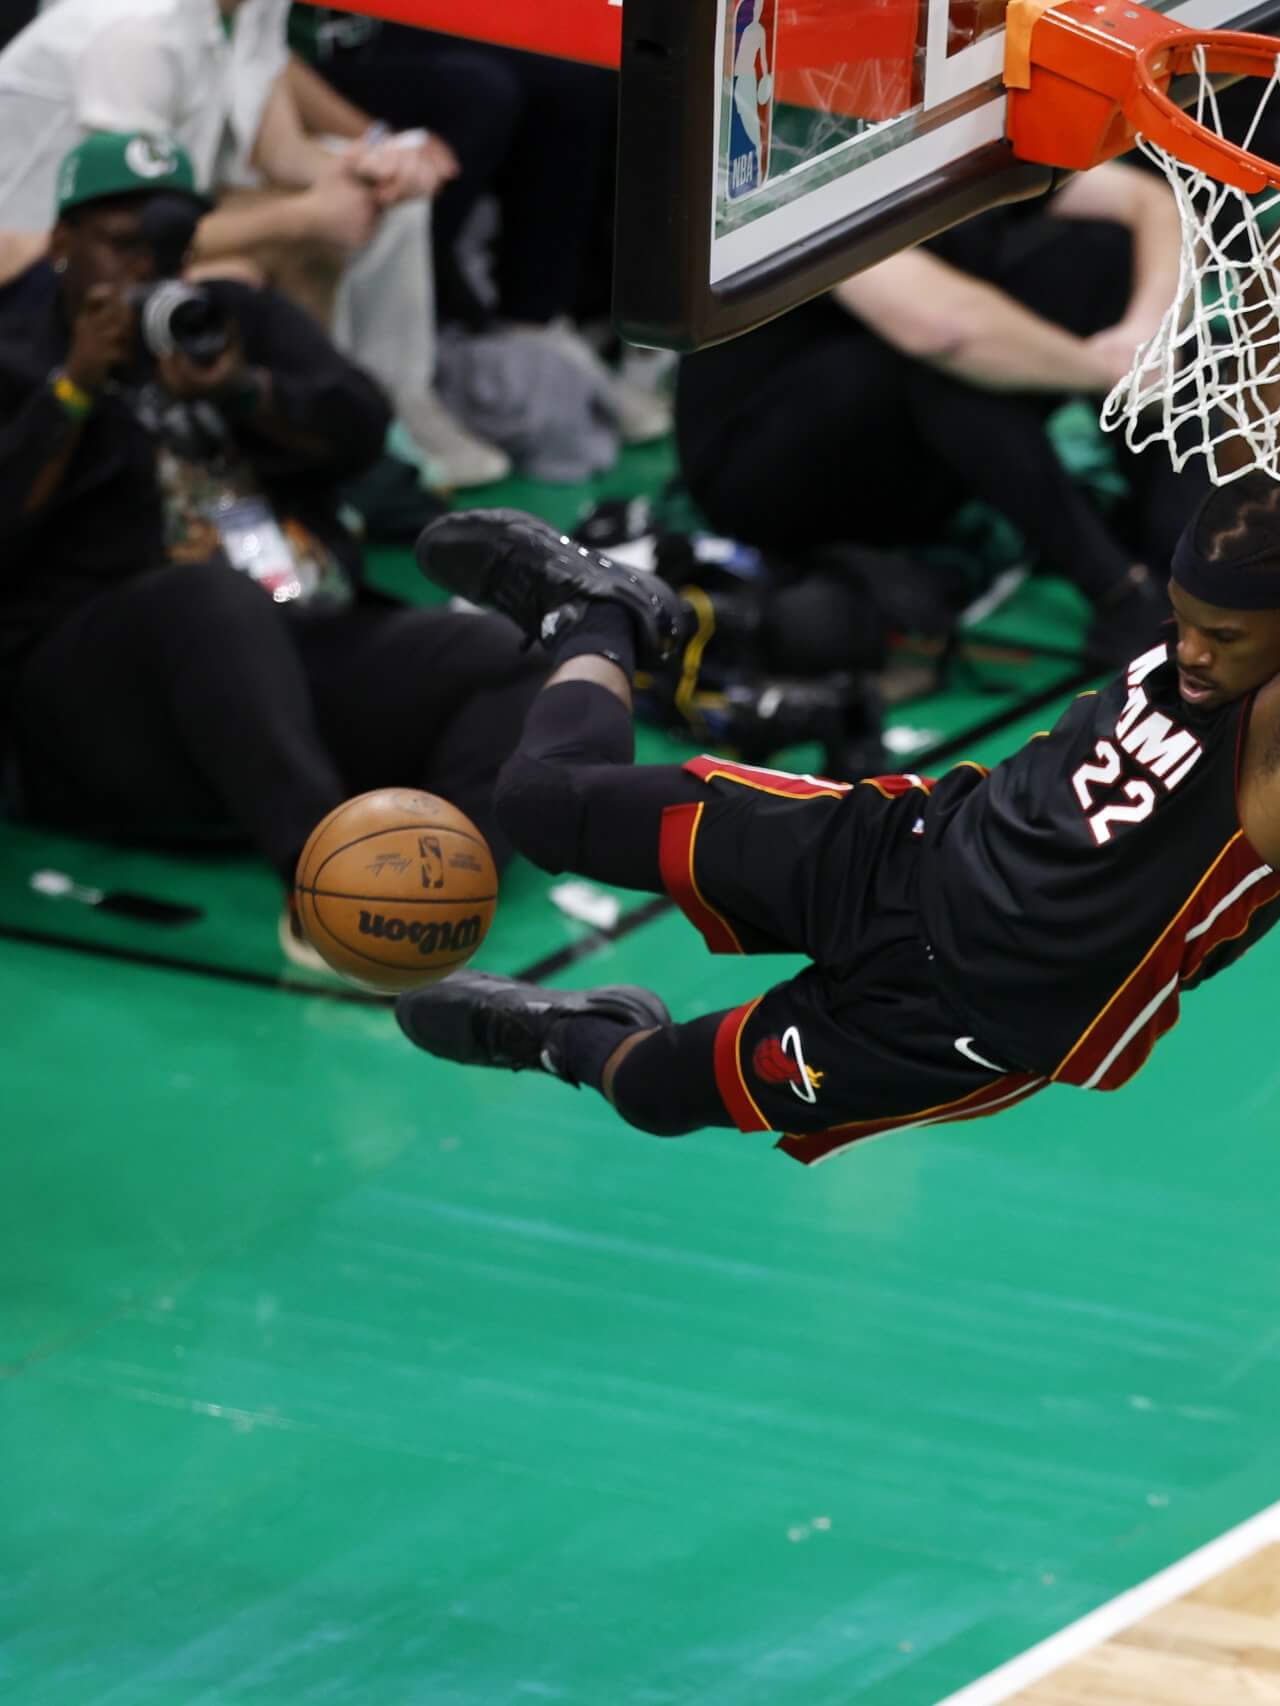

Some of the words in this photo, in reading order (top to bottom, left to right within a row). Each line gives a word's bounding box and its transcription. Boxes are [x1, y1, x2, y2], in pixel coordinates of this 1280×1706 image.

[732, 151, 752, 190] NBA
[1072, 738, 1156, 845] 22
[359, 910, 482, 957] Wilson
